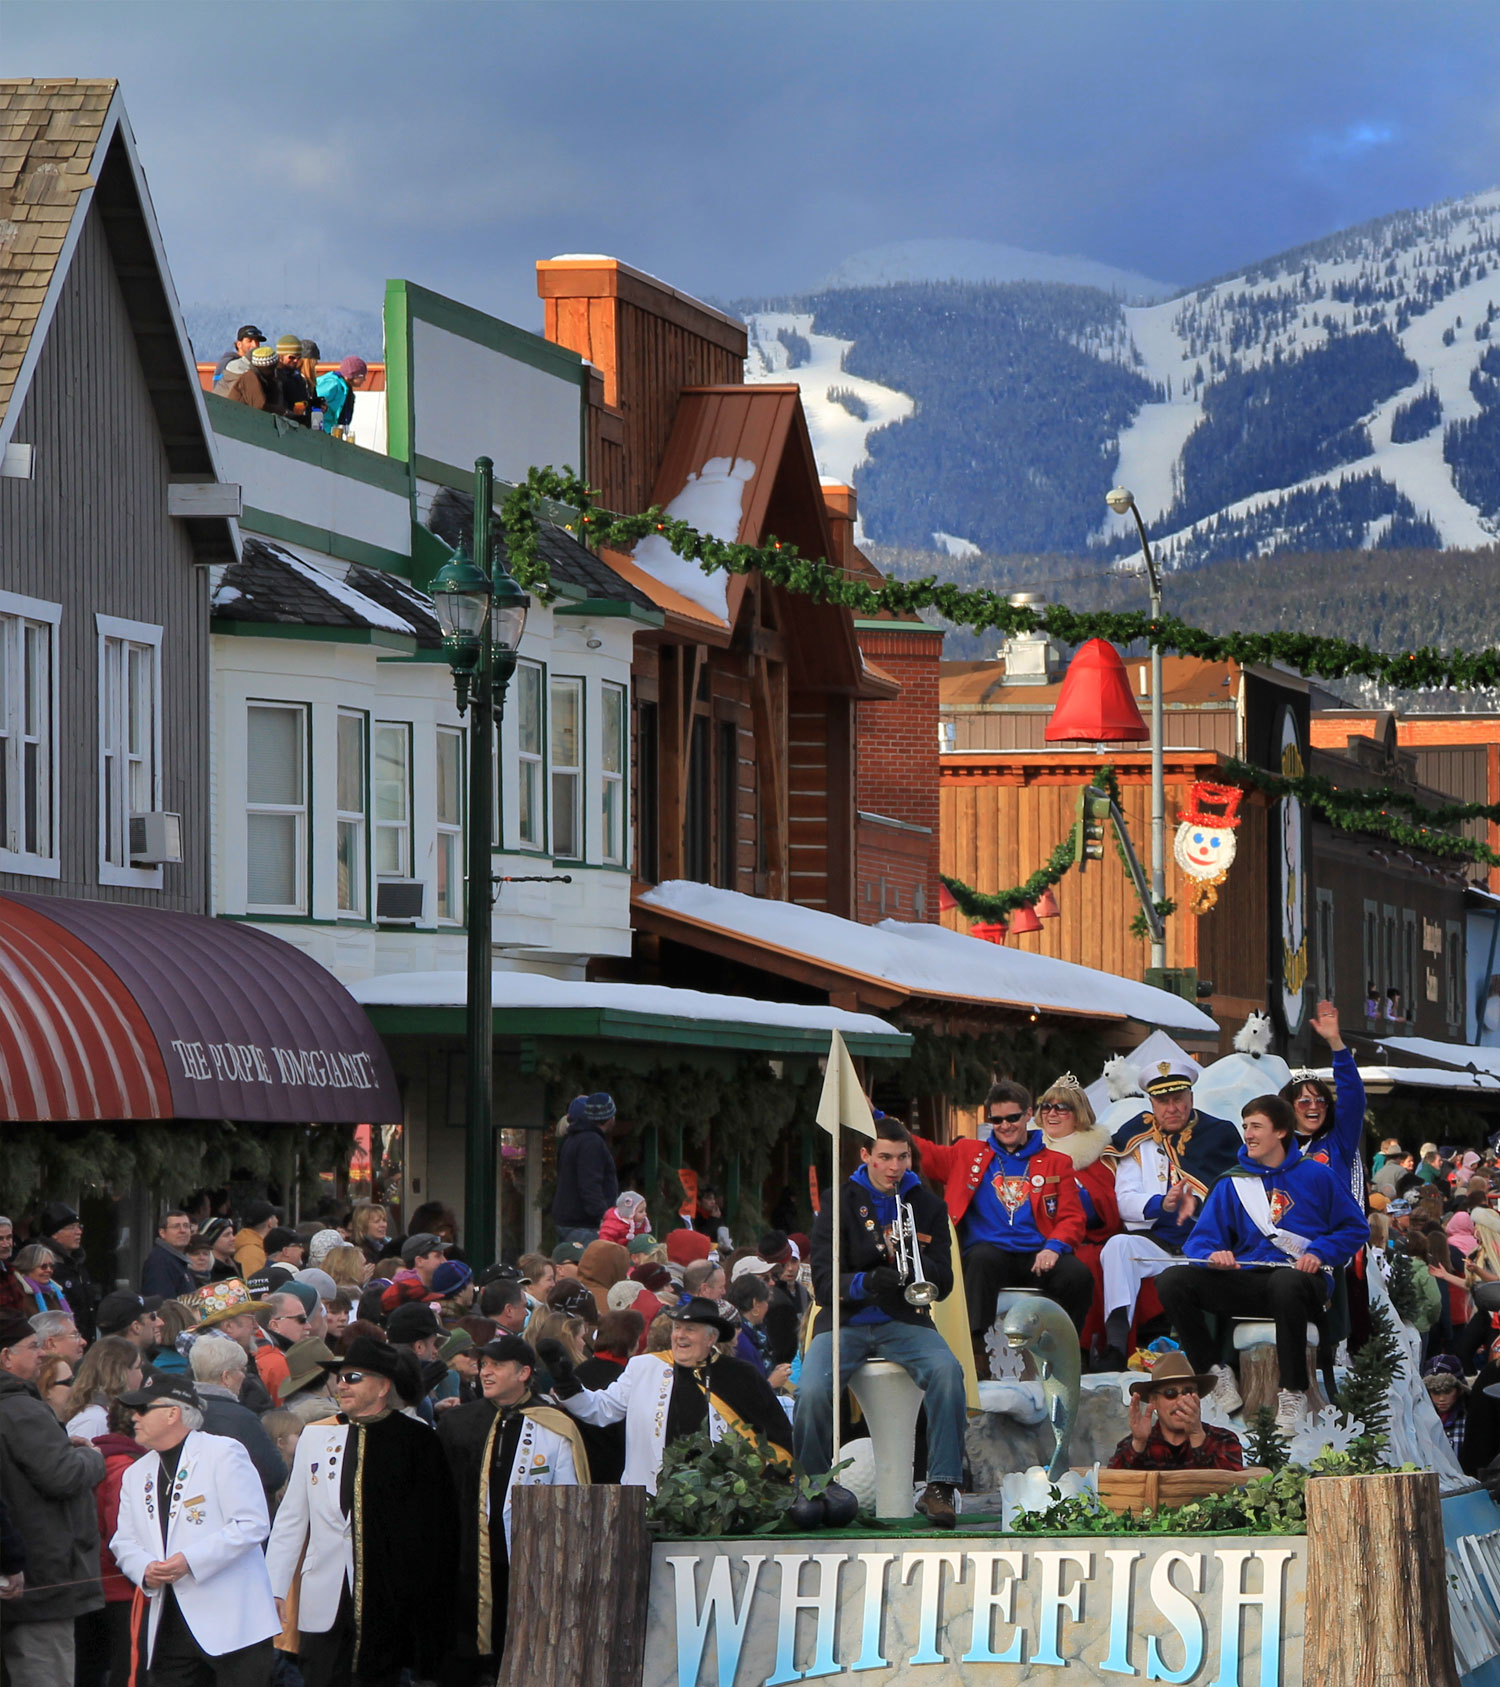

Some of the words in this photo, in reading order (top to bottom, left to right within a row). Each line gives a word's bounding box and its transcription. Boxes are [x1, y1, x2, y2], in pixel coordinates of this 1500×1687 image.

[170, 1040, 212, 1081] THE
[208, 1043, 273, 1084] PURPLE
[665, 1549, 1296, 1687] WHITEFISH
